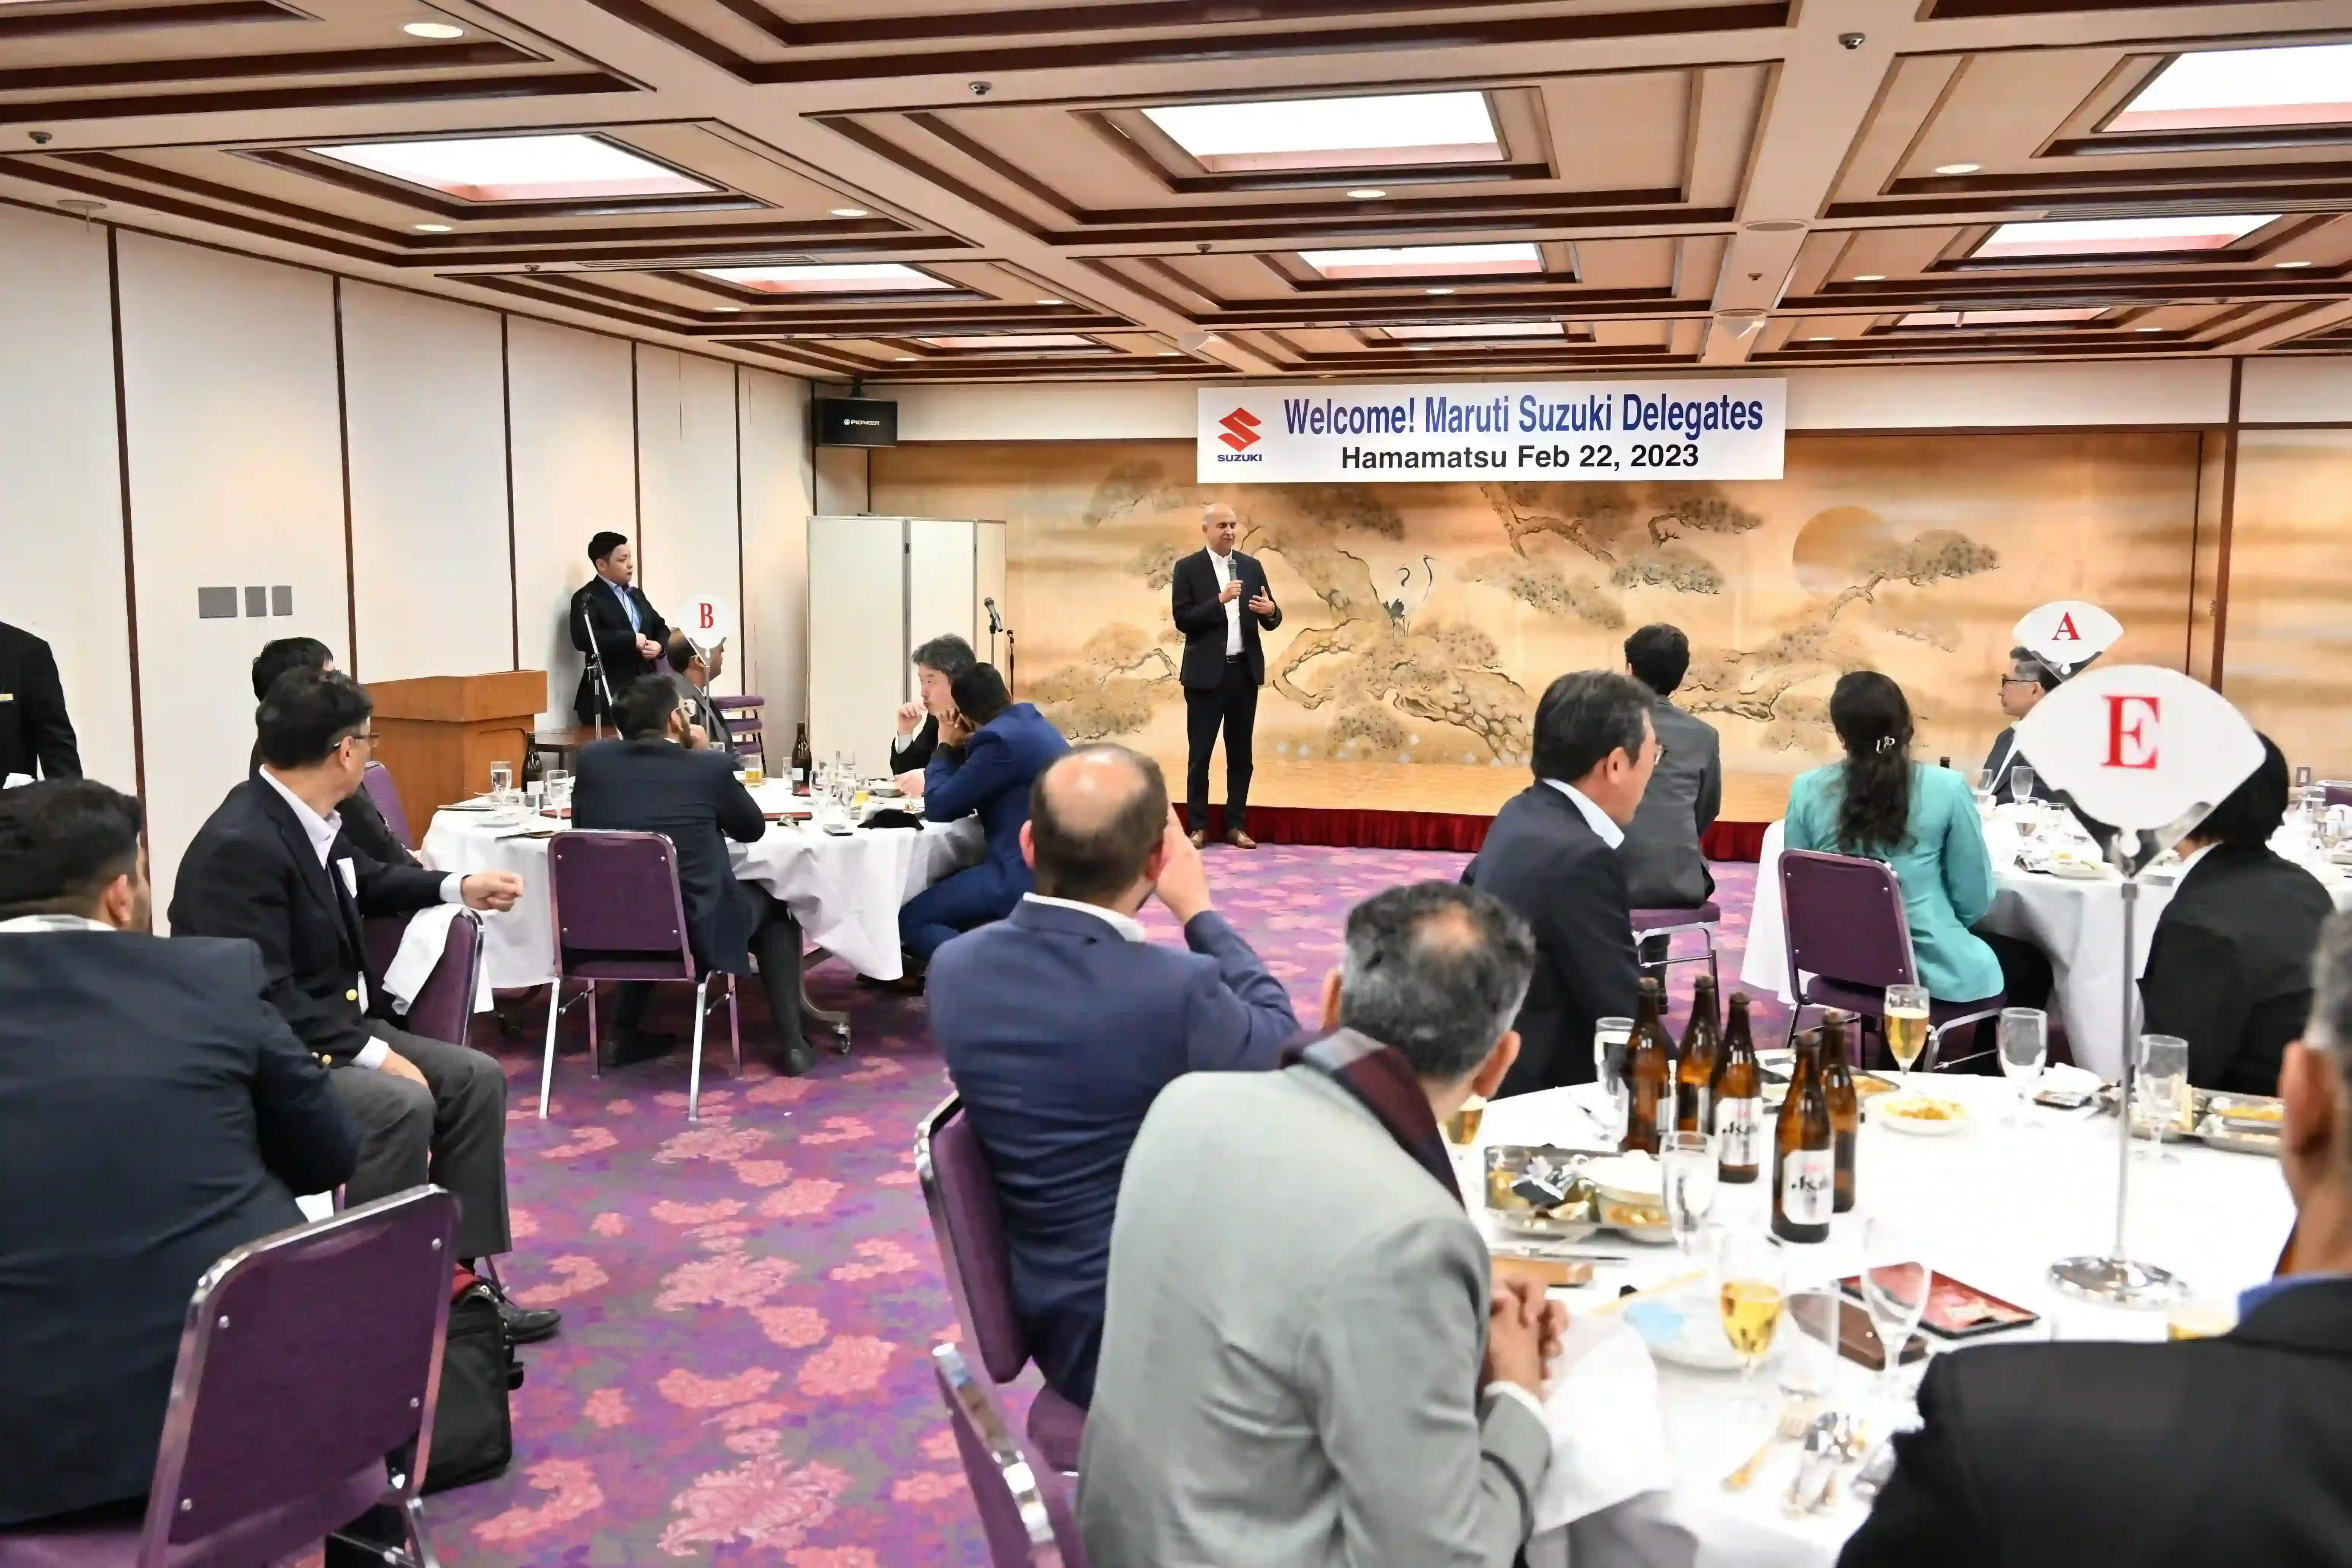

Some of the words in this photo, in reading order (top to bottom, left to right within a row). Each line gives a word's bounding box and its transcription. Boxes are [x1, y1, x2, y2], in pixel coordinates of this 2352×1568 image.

[1284, 397, 1415, 435] Welcome!
[1426, 395, 1509, 433] Maruti
[1519, 394, 1612, 433] Suzuki
[1623, 394, 1763, 441] Delegates
[1342, 447, 1506, 469] Hamamatsu
[1518, 445, 1570, 468] Feb
[1579, 445, 1620, 472] 22,
[1630, 444, 1698, 467] 2023
[699, 603, 714, 629] B
[2051, 612, 2082, 640] A
[2101, 695, 2160, 770] E
